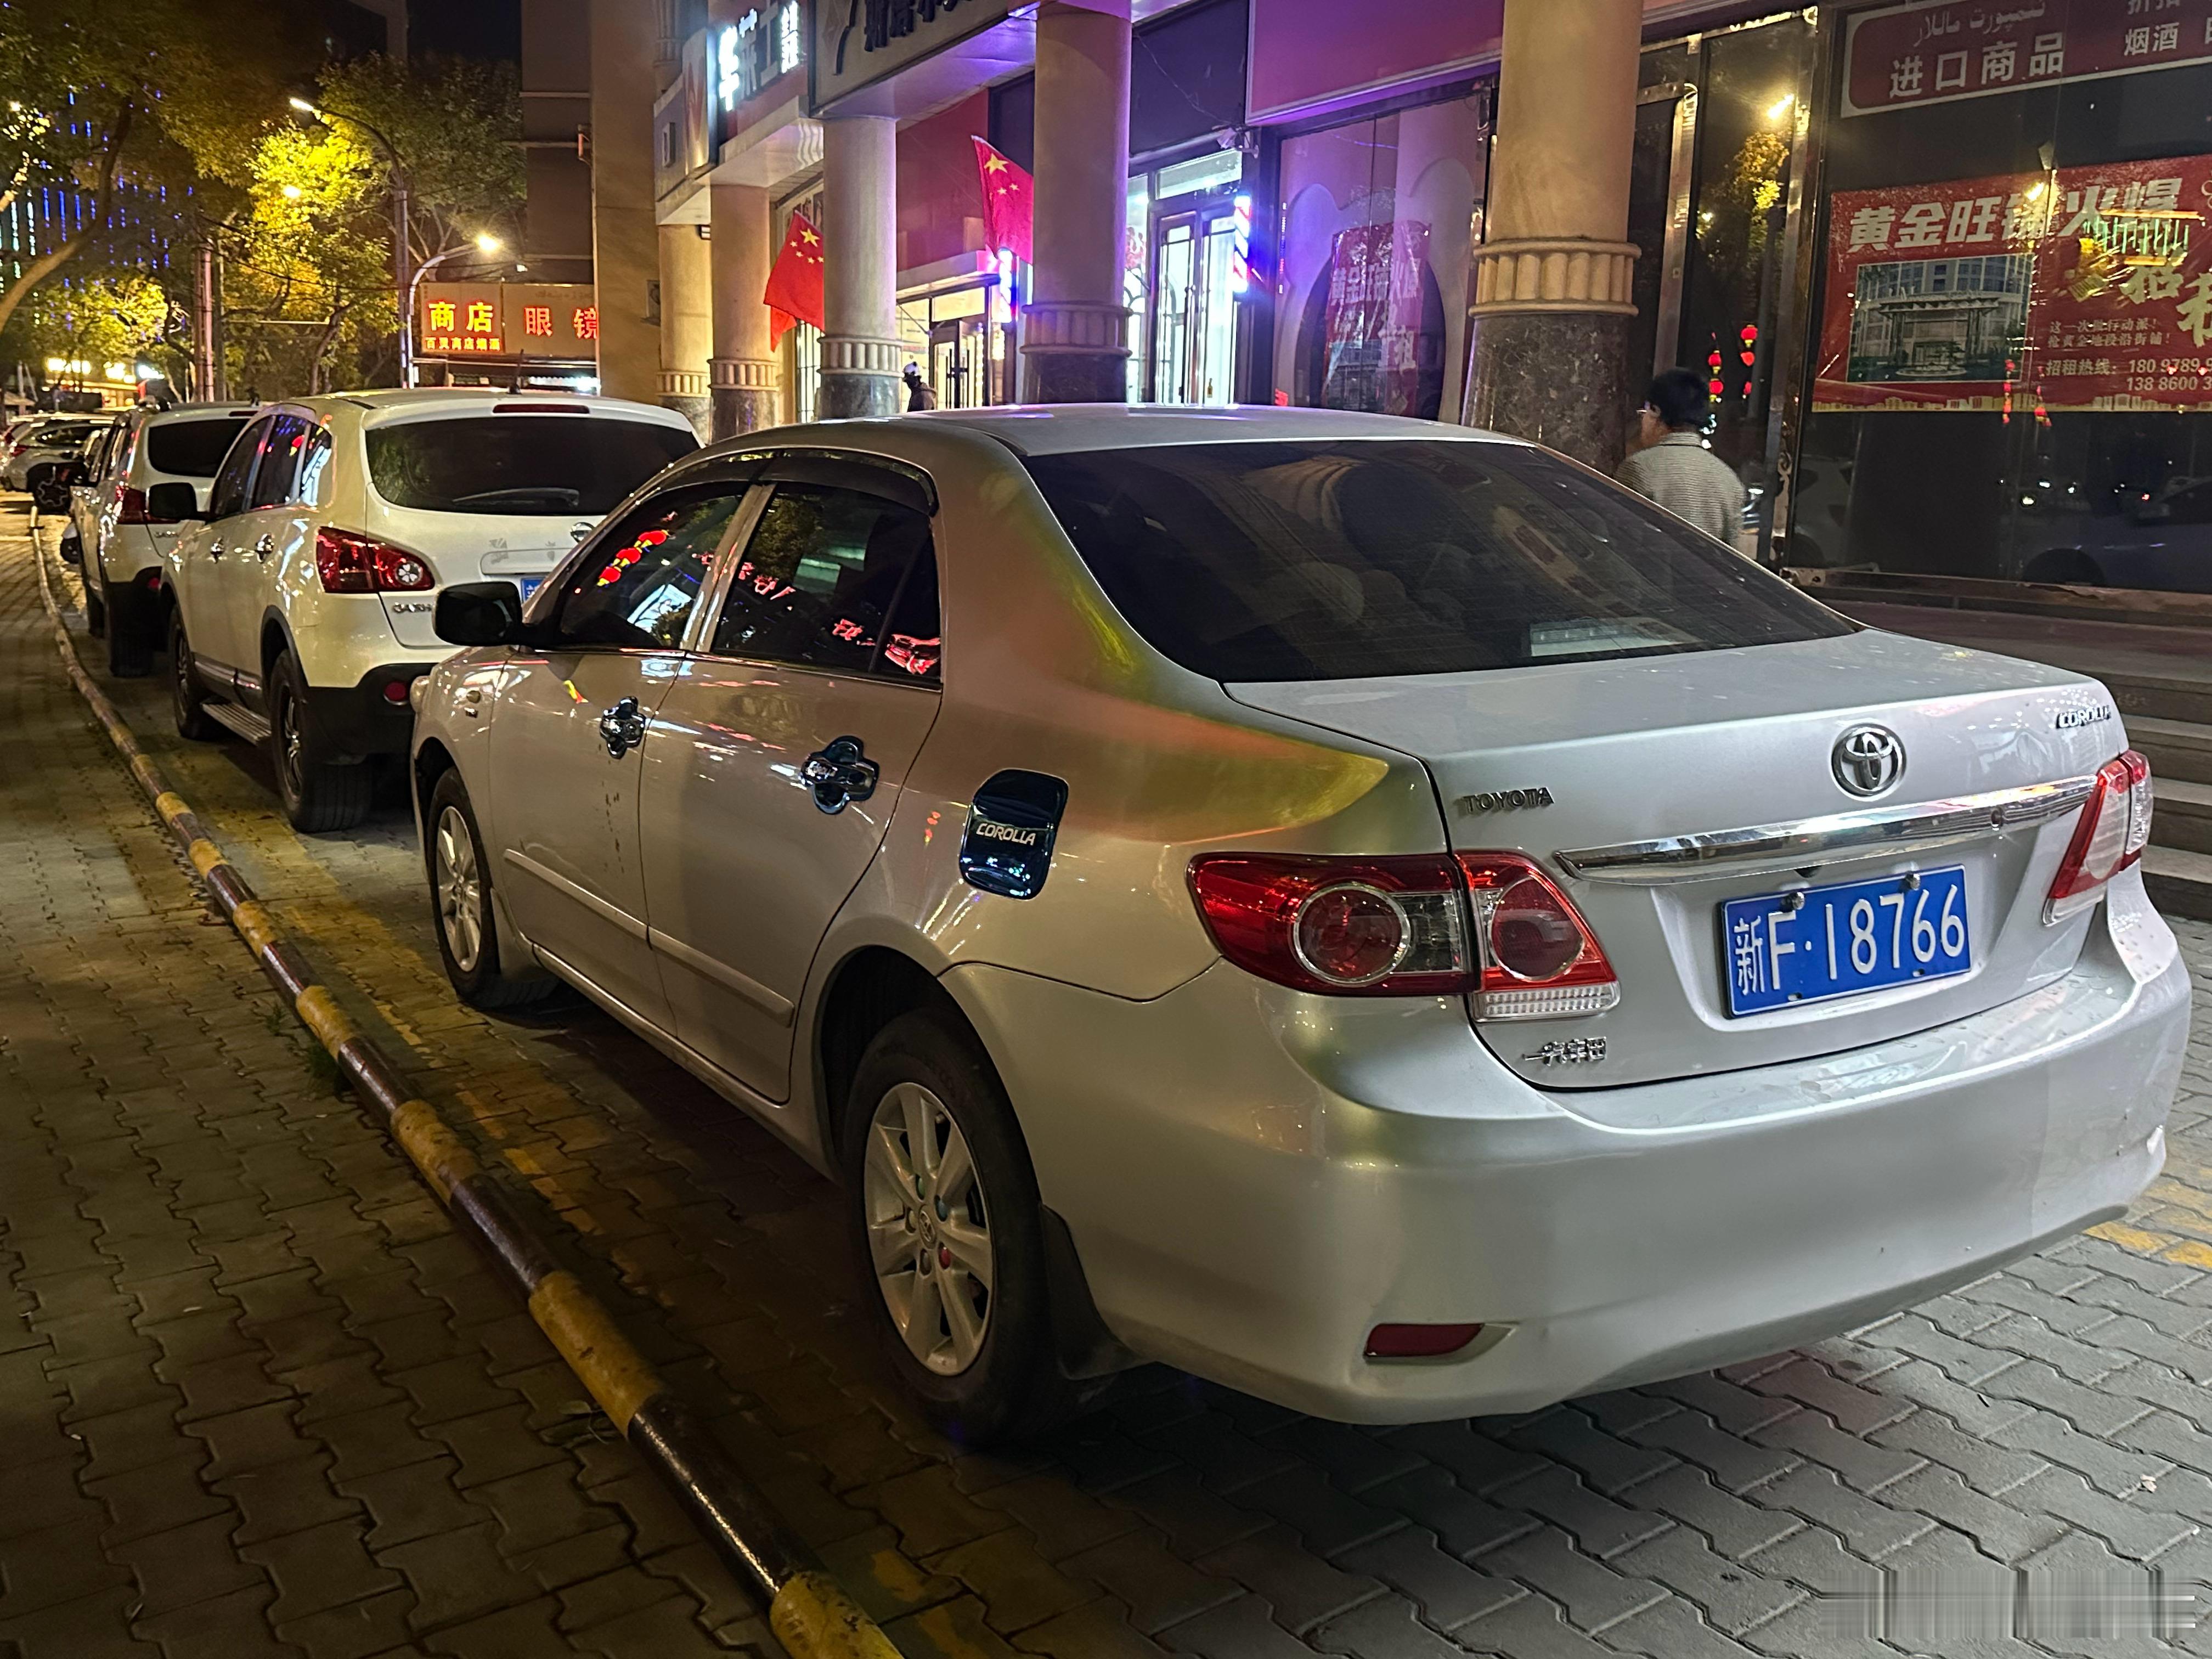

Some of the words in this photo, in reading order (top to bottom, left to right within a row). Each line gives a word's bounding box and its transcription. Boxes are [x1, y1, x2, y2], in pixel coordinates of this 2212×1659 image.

[2124, 22, 2180, 55] 烟酒
[1889, 32, 2064, 99] 进口商品
[428, 301, 493, 332] 商店
[524, 307, 597, 339] 眼镜
[2129, 359, 2156, 373] 180
[2126, 377, 2154, 391] 138
[2158, 376, 2198, 390] 8600
[1462, 787, 1555, 814] TOYOTA
[976, 823, 1036, 846] COROLLA
